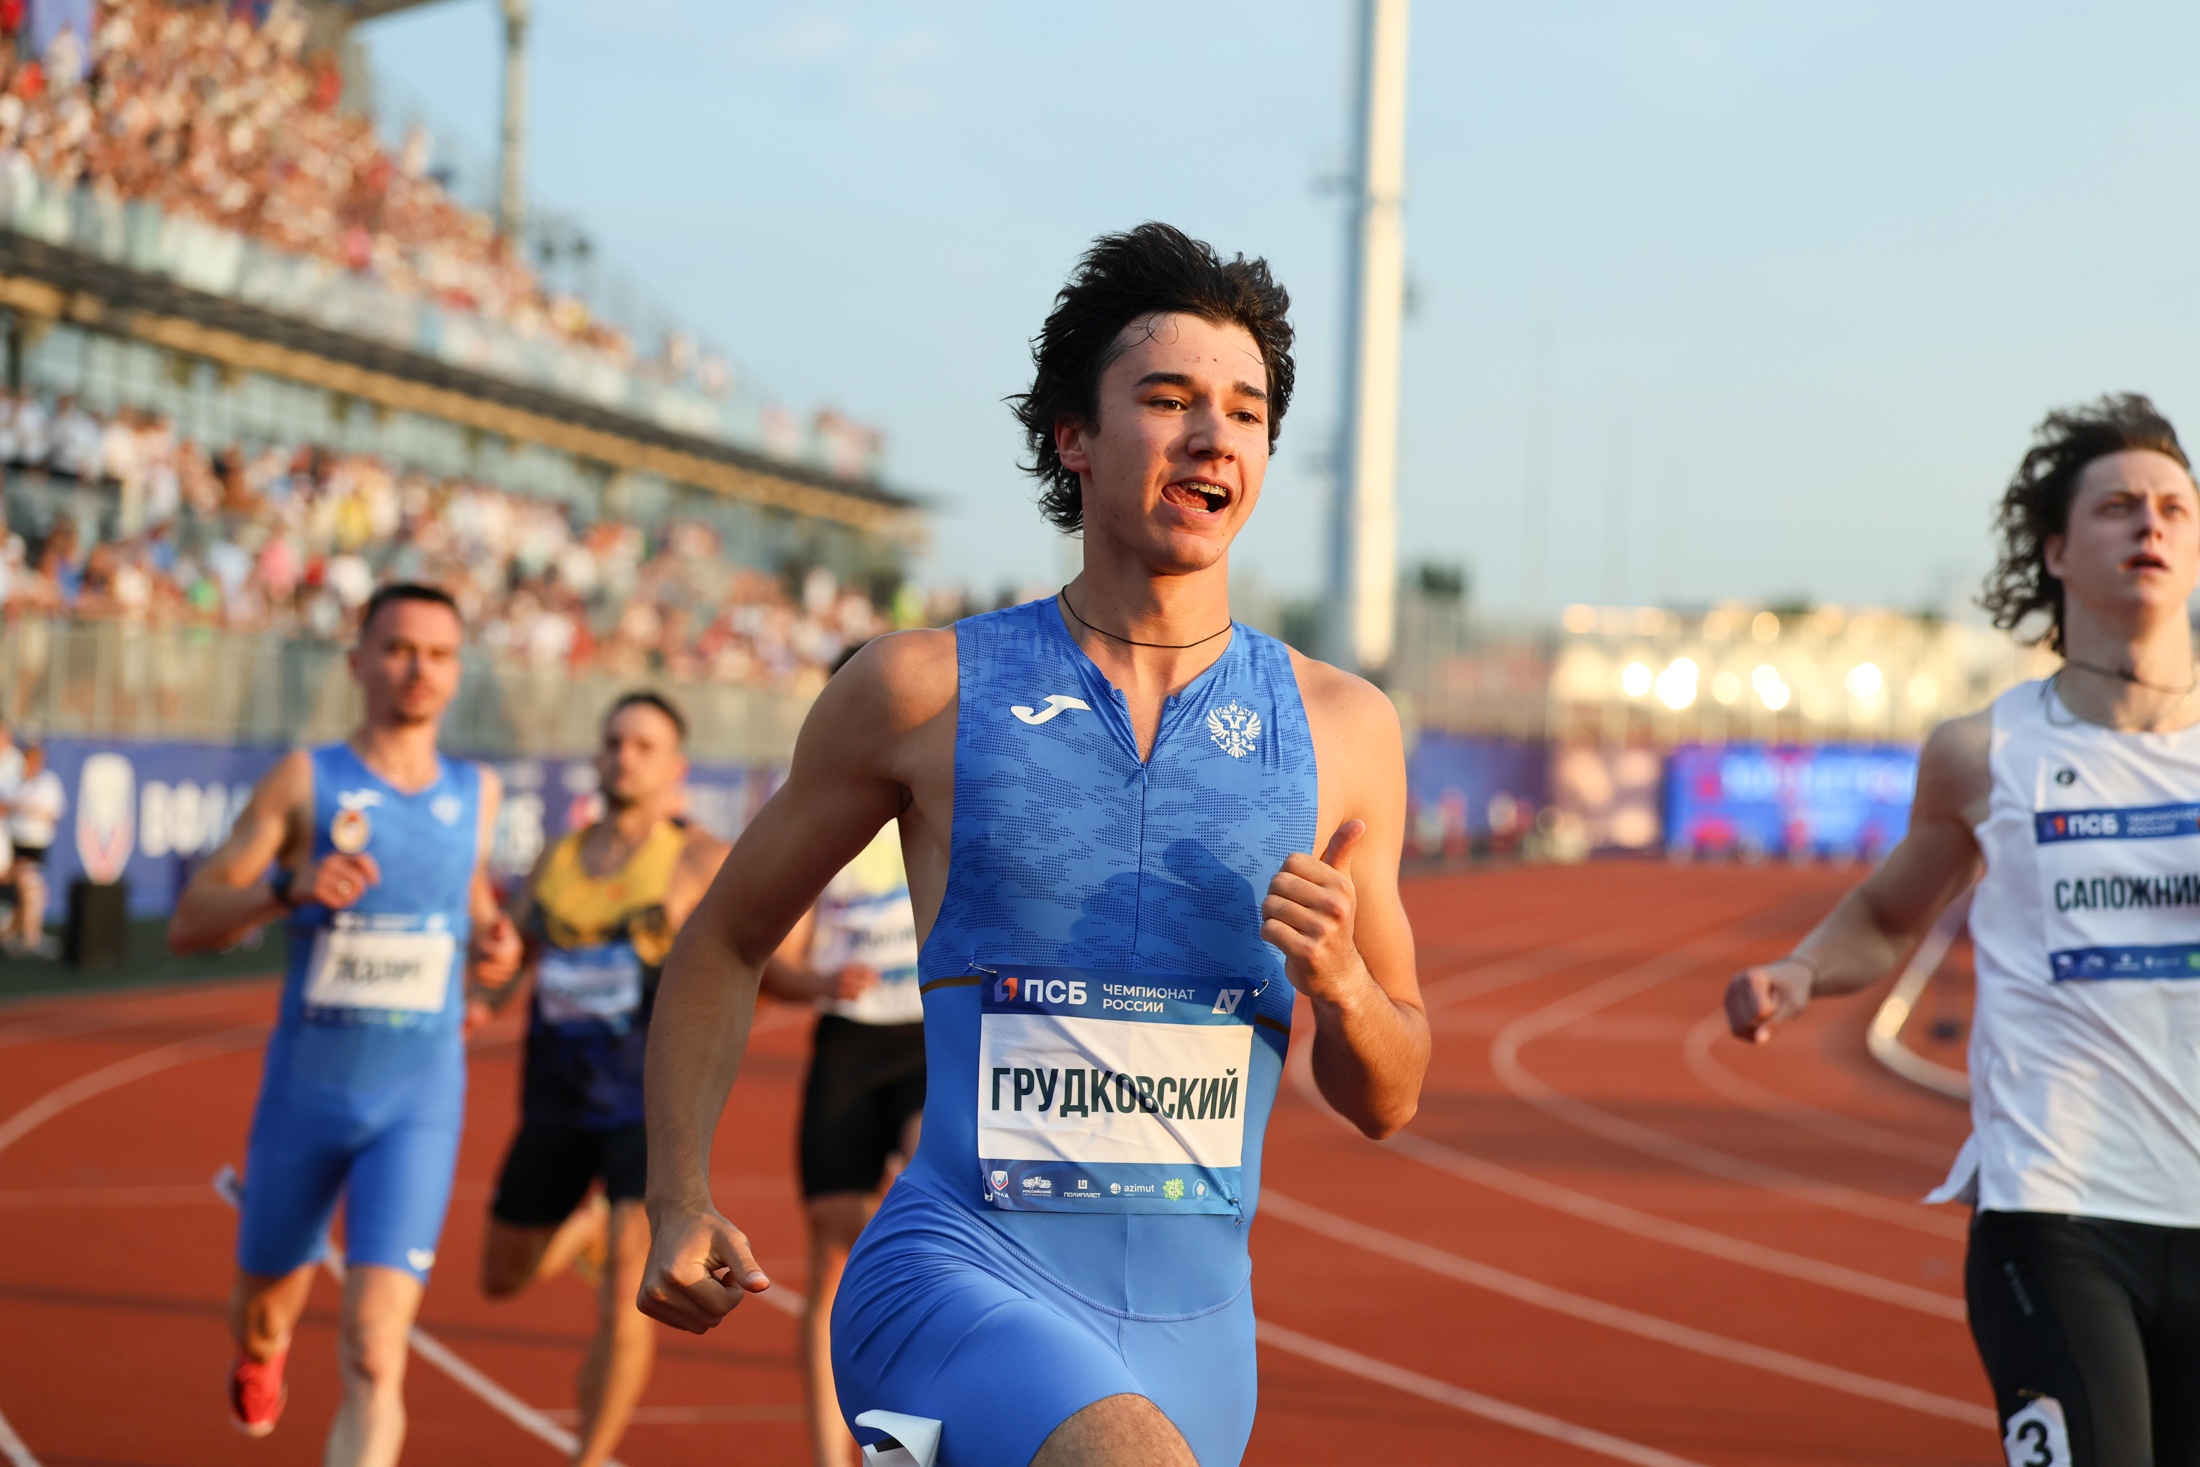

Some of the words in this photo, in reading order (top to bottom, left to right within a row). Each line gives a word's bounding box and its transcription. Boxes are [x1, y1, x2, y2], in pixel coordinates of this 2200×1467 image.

[2068, 813, 2119, 836] ПСБ
[1024, 979, 1087, 1005] ПСБ
[1103, 983, 1196, 1001] ЧЕМПИОНАТ
[1103, 998, 1164, 1013] РОССИИ
[991, 1067, 1239, 1121] ГРУДКОВСКИЙ
[1124, 1183, 1155, 1193] azimut
[2016, 1419, 2053, 1467] 3
